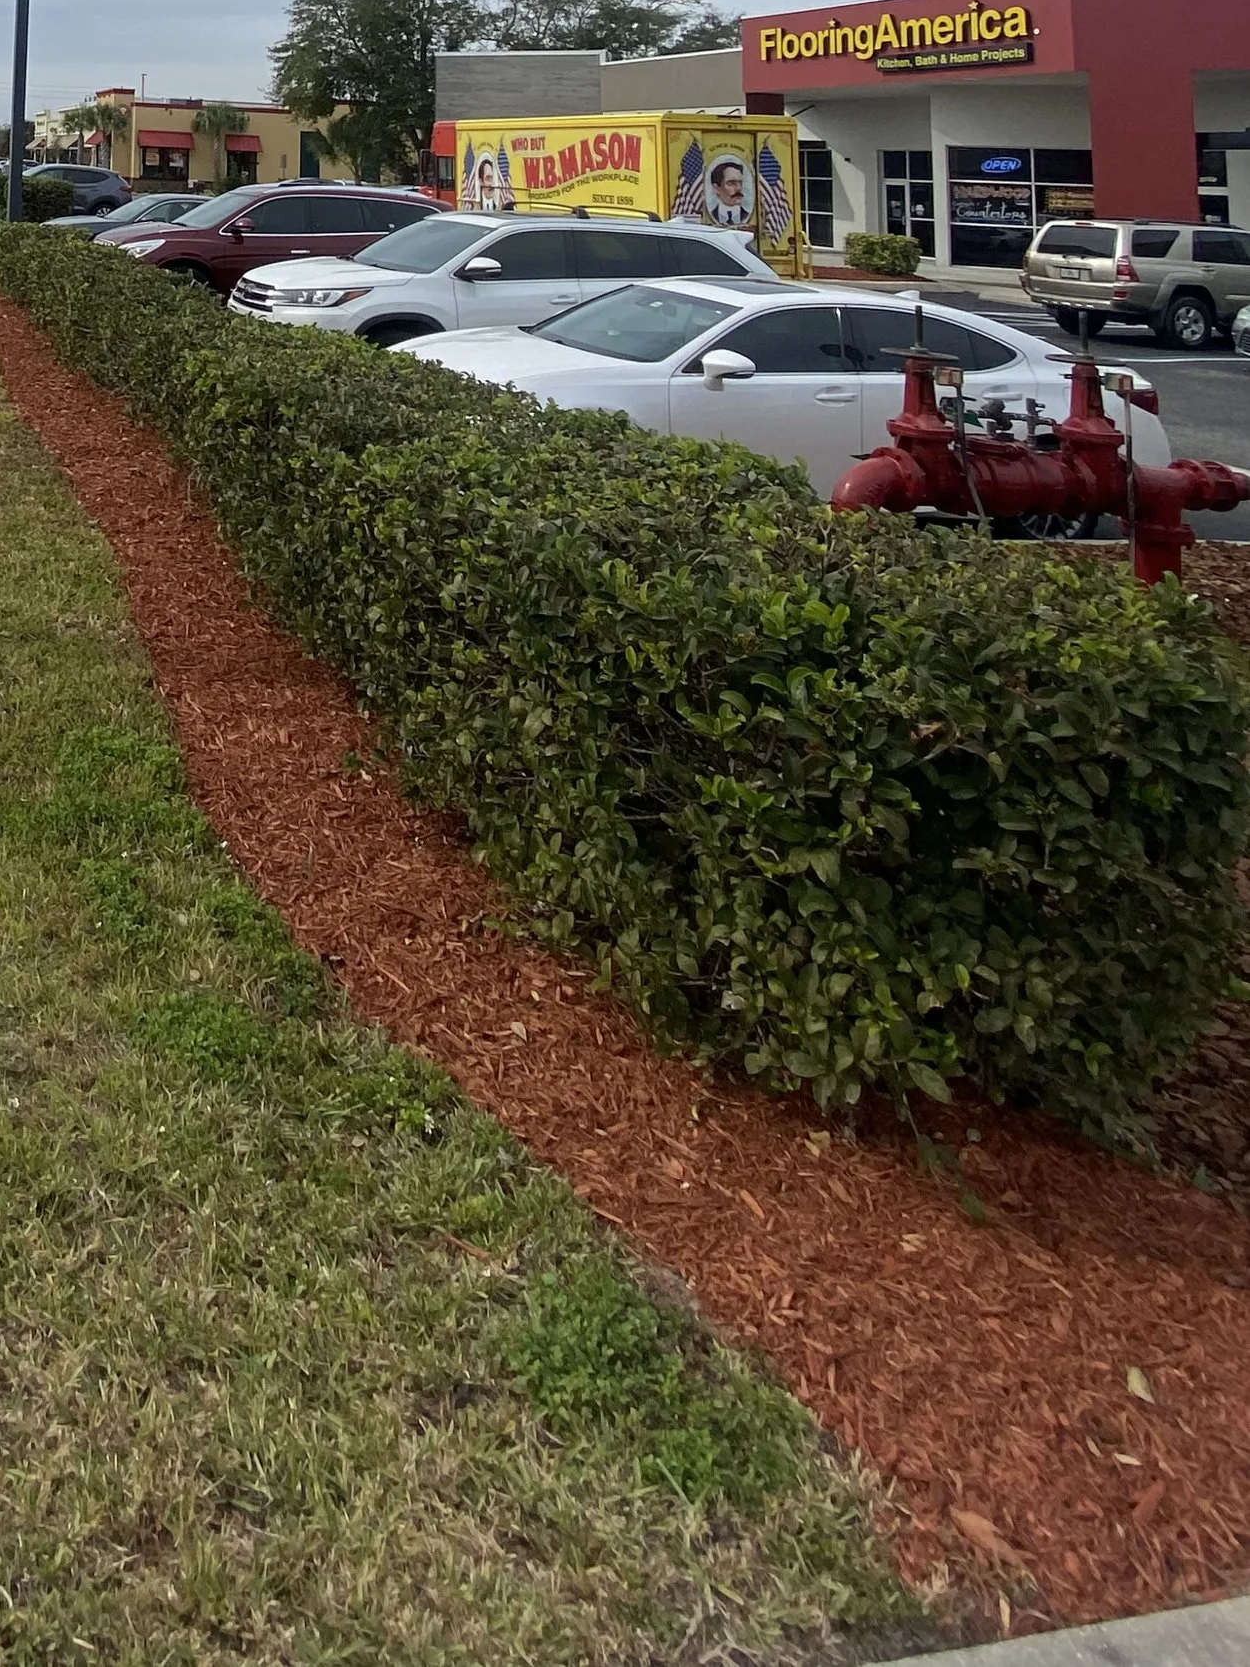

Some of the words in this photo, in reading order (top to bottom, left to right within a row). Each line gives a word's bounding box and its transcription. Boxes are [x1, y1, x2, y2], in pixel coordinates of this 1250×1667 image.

[877, 58, 913, 69] Kitchen,
[915, 55, 937, 66] Bath
[940, 54, 947, 64] &
[950, 52, 978, 63] Home
[981, 48, 1025, 62] Projects
[510, 137, 528, 153] WHO
[530, 136, 546, 151] BUT
[983, 160, 1017, 171] OPEN
[561, 184, 575, 195] FOR
[576, 177, 591, 187] THE
[591, 174, 639, 185] WORKPLACE
[592, 194, 615, 205] SINCE
